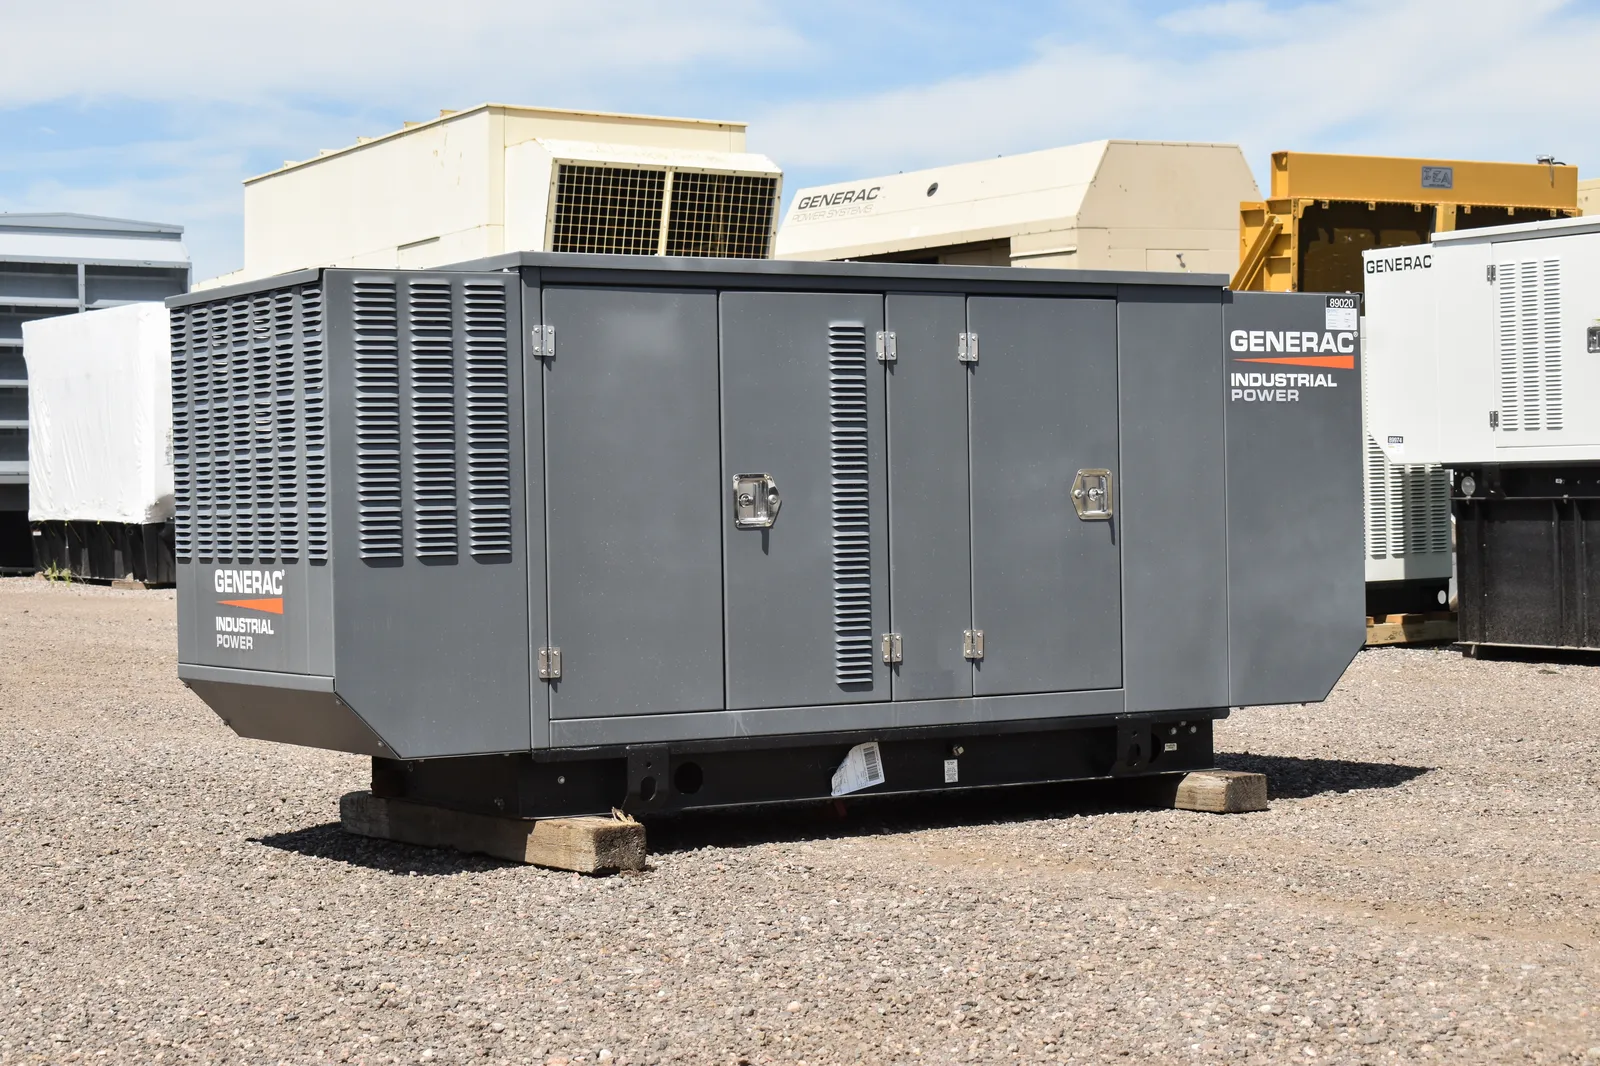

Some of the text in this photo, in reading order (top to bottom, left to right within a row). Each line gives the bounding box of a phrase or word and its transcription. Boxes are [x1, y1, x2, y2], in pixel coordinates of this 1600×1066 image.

[798, 187, 881, 210] GENERAC
[792, 204, 874, 222] POWER SYSTEMS
[1366, 254, 1432, 274] GENERAC
[1329, 298, 1354, 308] 89020
[1231, 373, 1338, 388] INDUSTRIAL
[1231, 388, 1300, 402] POWER
[215, 616, 275, 635] INDUSTRIAL
[216, 634, 253, 650] POWER
